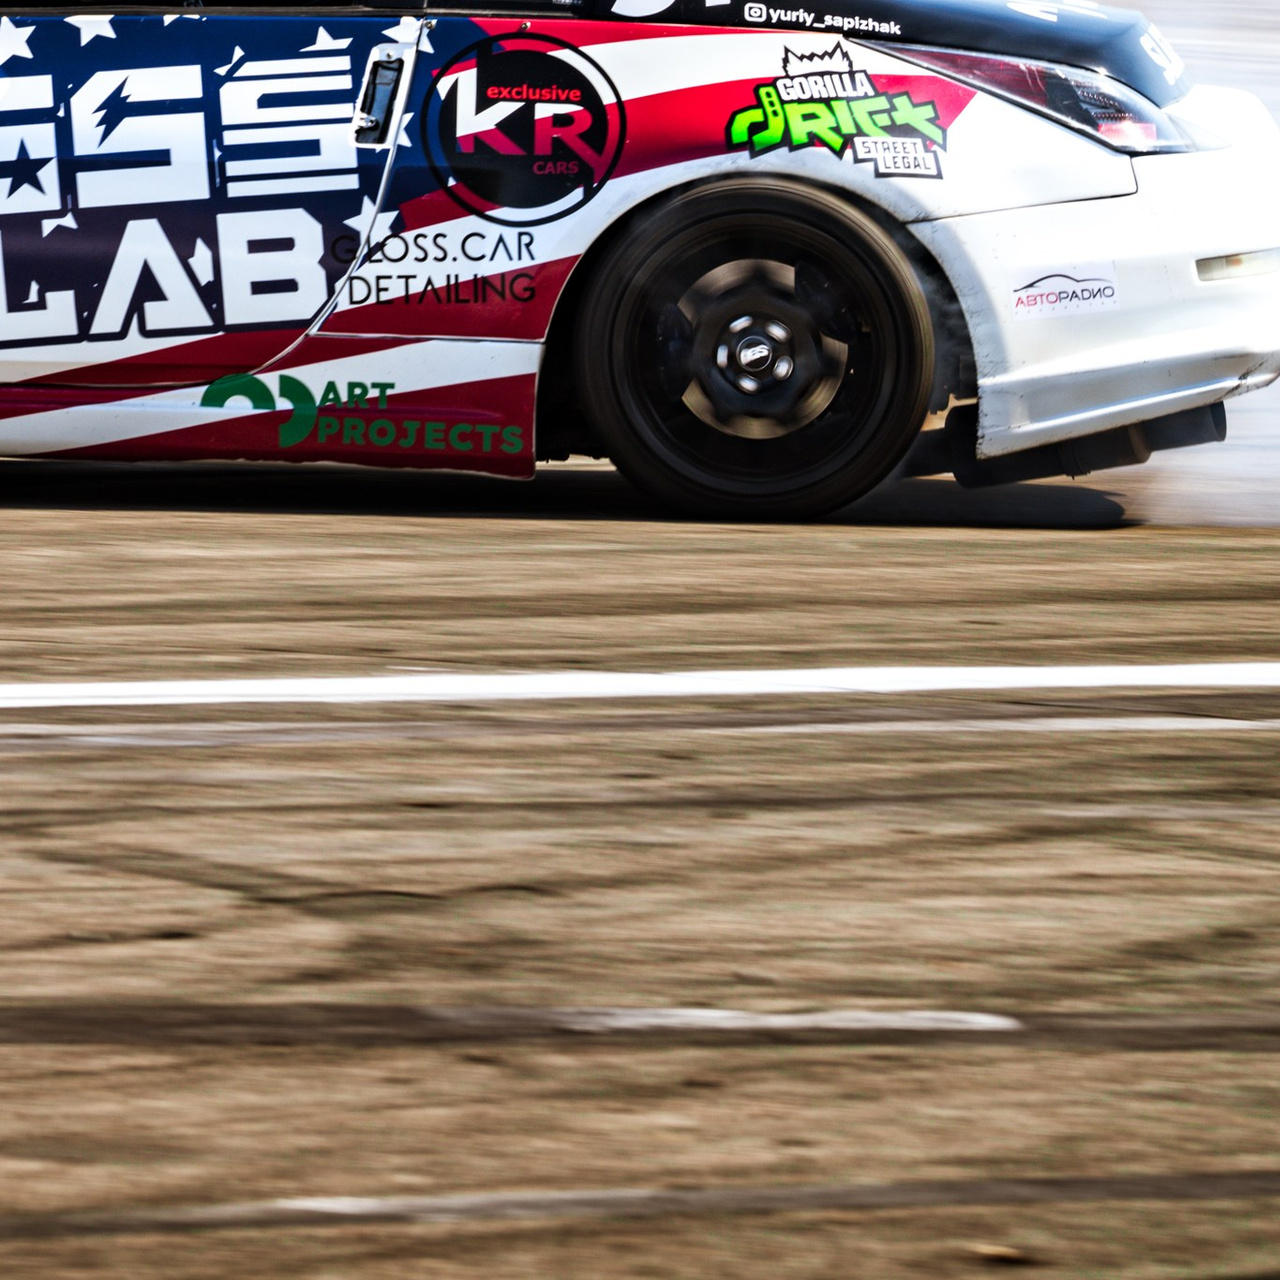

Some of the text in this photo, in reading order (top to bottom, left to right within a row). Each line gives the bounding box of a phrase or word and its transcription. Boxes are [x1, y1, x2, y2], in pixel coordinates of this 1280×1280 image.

[769, 8, 901, 35] yuriy_sapizhak
[486, 84, 582, 101] exclusive
[776, 70, 875, 101] GORILLA
[455, 68, 605, 158] KR
[862, 141, 919, 155] STREET
[533, 161, 579, 175] CARS
[884, 155, 932, 170] LEGAL
[348, 272, 536, 306] DETAILING
[321, 380, 396, 410] ART
[317, 417, 524, 454] PROJECTS
